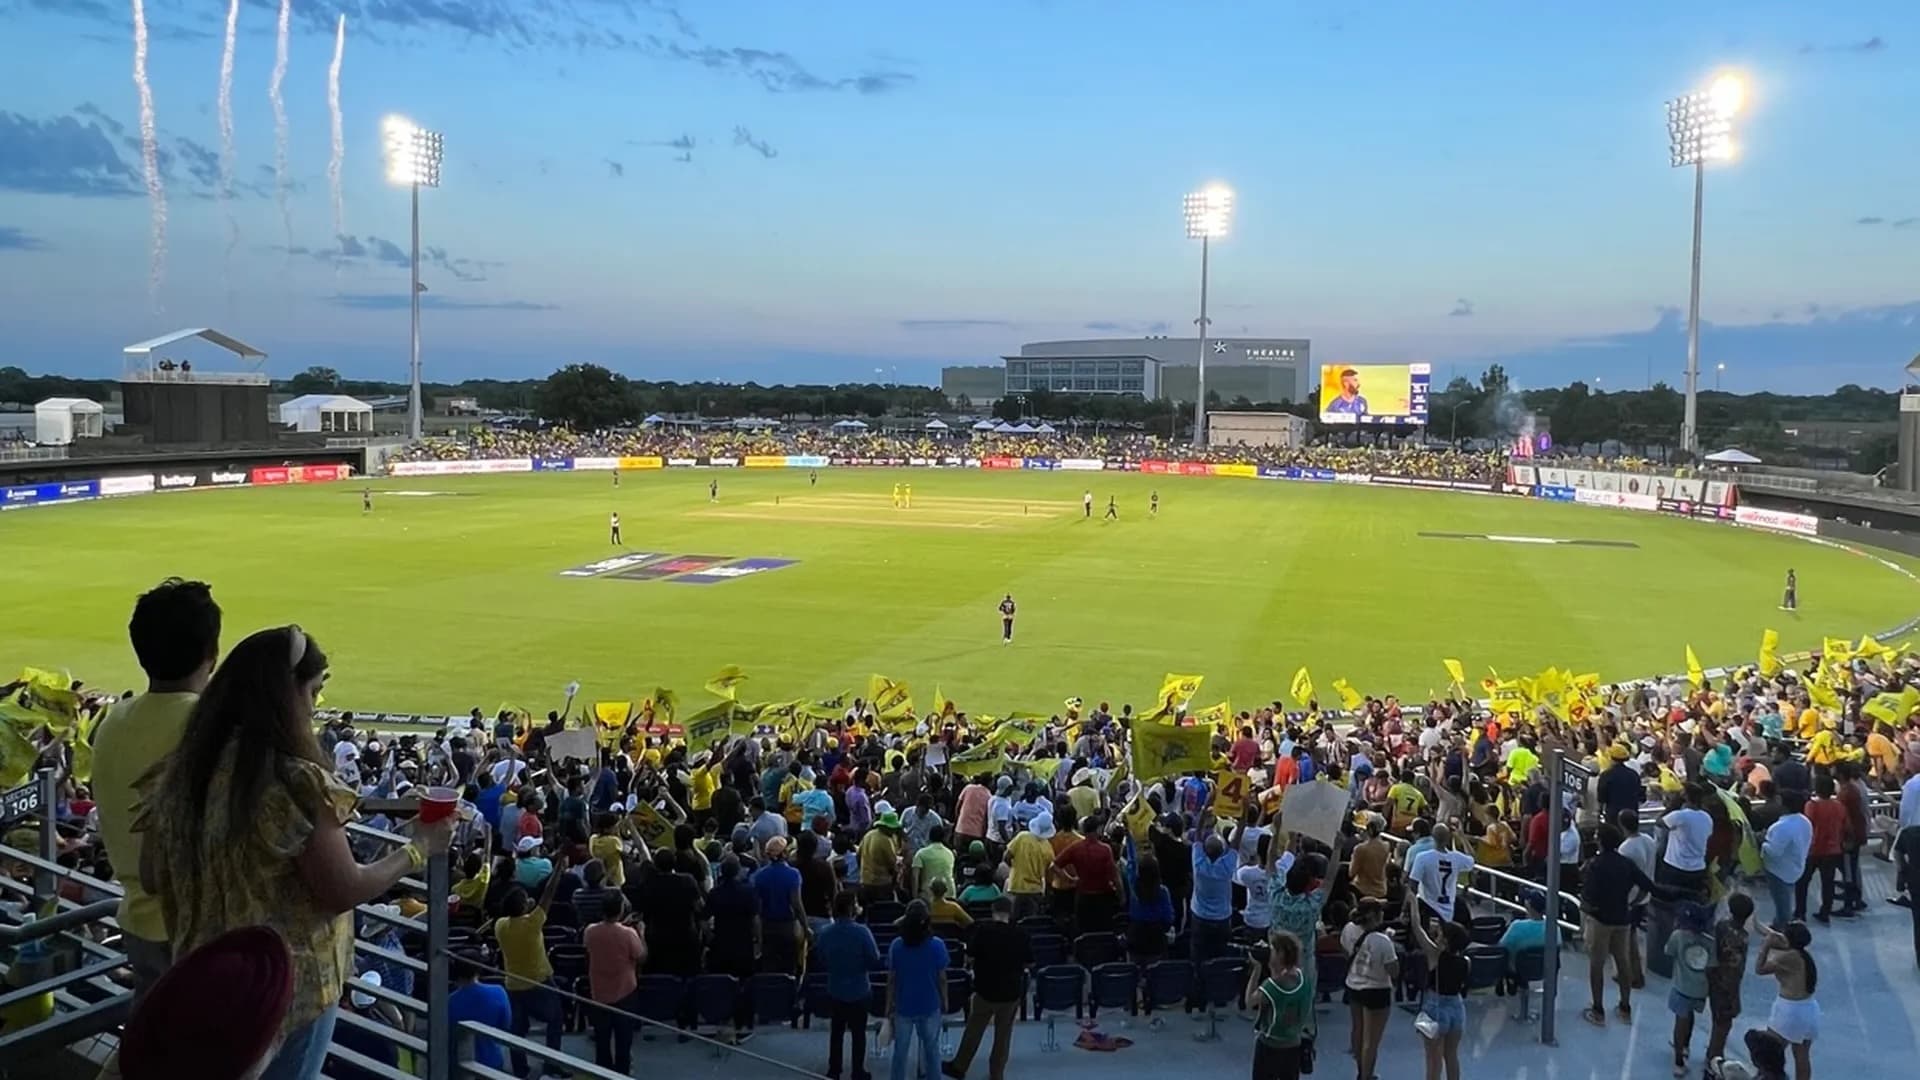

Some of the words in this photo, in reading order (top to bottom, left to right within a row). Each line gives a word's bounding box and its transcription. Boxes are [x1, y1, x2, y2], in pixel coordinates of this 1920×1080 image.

[1246, 349, 1295, 357] THEATRE
[1222, 777, 1242, 803] 4
[1564, 771, 1582, 790] 106
[6, 785, 38, 803] SECTION
[12, 793, 38, 816] 106
[1406, 797, 1415, 811] 7
[1438, 866, 1452, 896] 7
